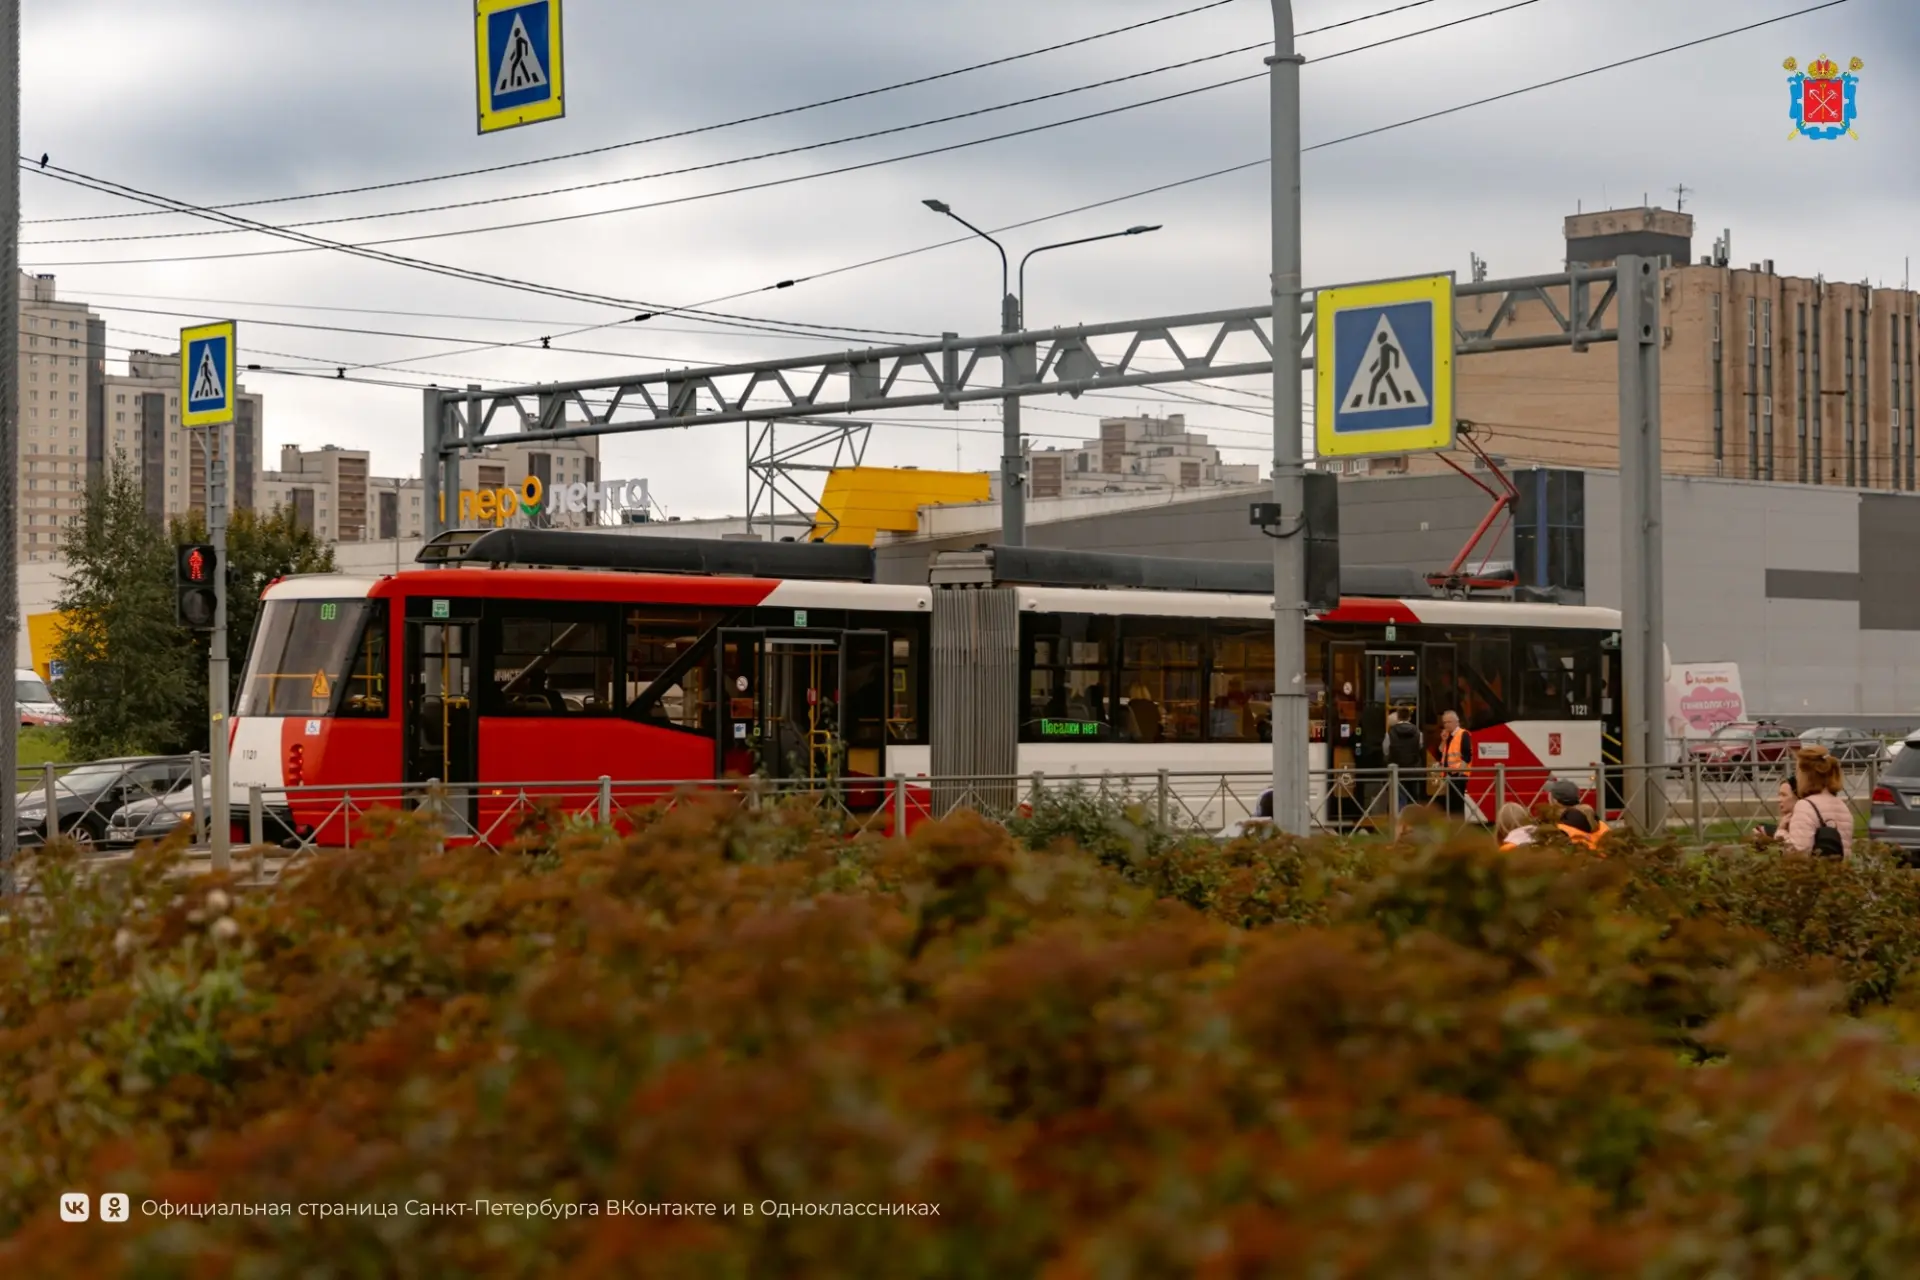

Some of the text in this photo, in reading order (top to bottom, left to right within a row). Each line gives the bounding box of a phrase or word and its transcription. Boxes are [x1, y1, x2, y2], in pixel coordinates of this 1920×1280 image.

[1570, 704, 1587, 715] 1121
[1041, 718, 1098, 735] Посадки нет
[242, 749, 257, 760] 1121
